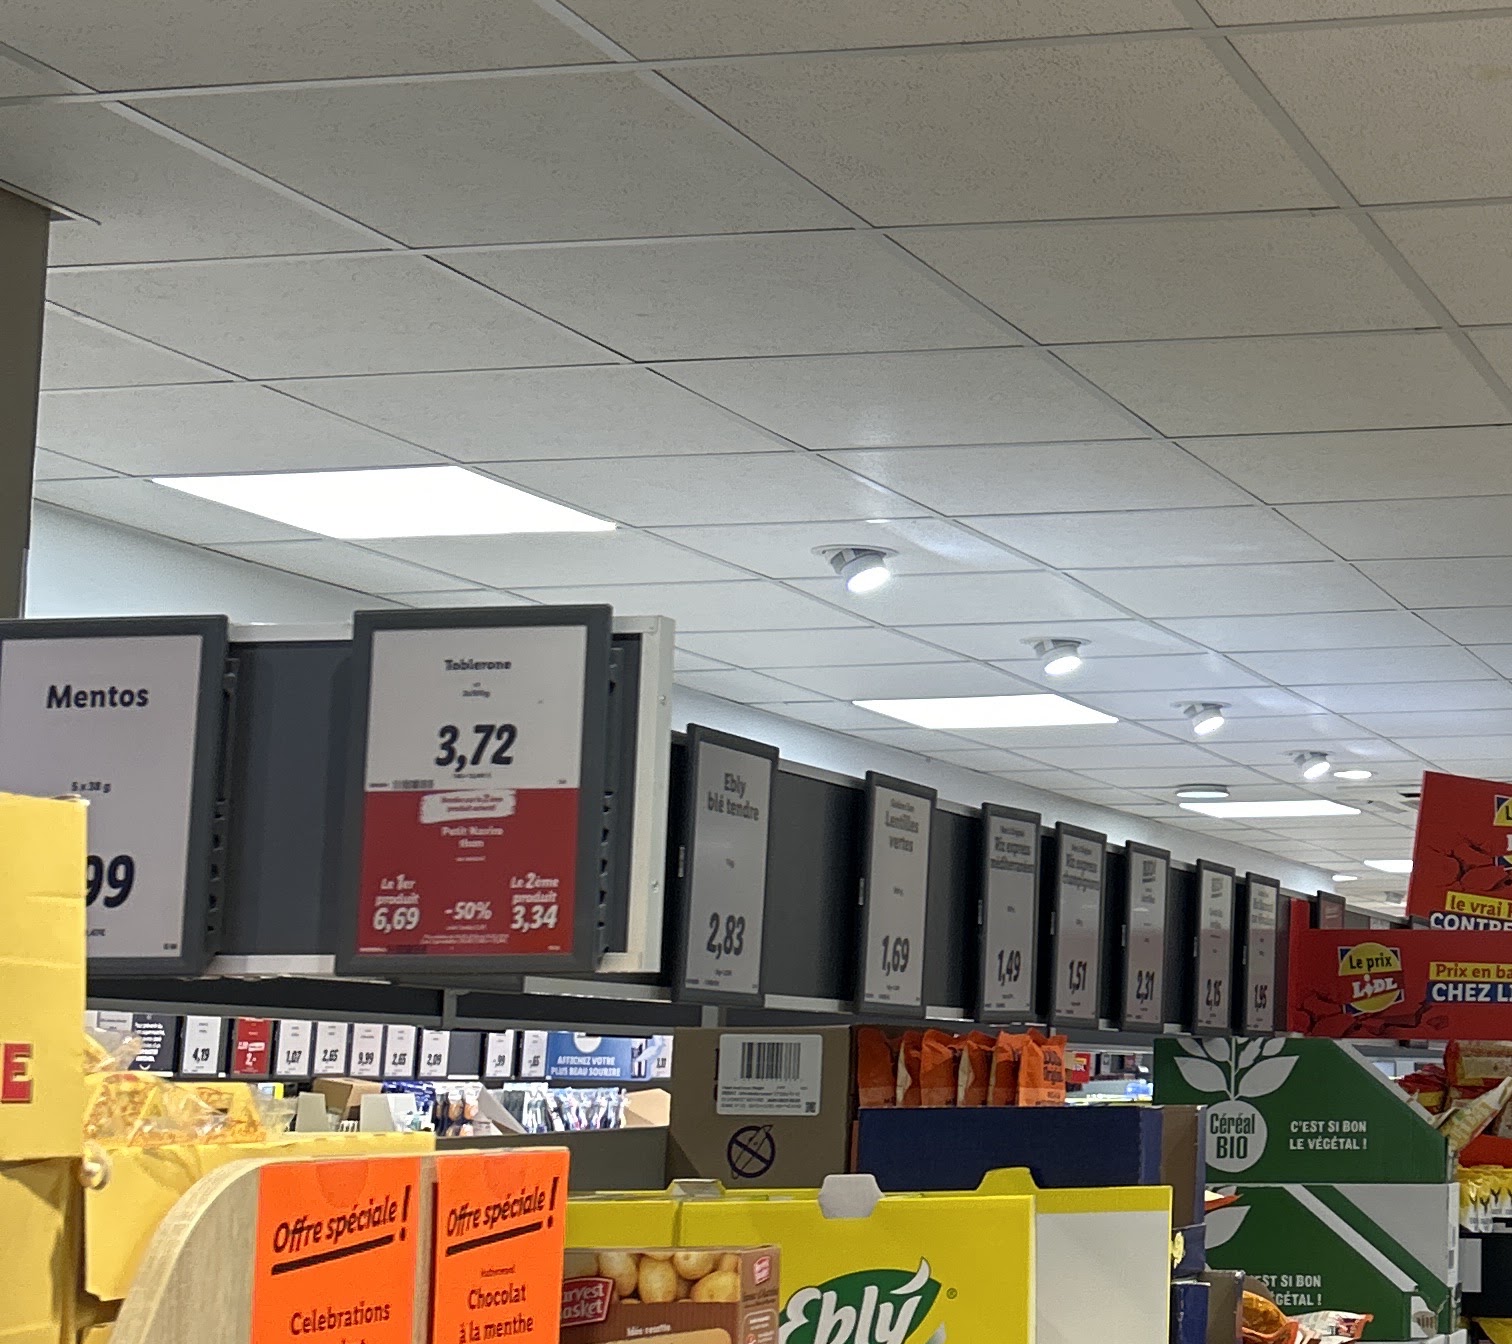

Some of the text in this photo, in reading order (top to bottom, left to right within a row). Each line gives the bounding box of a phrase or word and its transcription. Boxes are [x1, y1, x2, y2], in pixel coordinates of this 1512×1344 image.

[445, 659, 512, 672] Toblerone
[46, 684, 150, 710] Mentos
[435, 722, 519, 773] 3,72
[723, 772, 747, 799] Ebly
[707, 791, 760, 822] blé tendre
[380, 878, 395, 890] Le
[510, 876, 525, 889] Le
[375, 894, 420, 907] produit
[512, 891, 558, 904] produit
[1450, 895, 1467, 912] le
[1470, 901, 1504, 918] vrai
[373, 907, 420, 934] 6,69
[444, 901, 493, 921] -50%
[510, 904, 559, 933] 3,34
[706, 911, 746, 959] 2,83
[881, 935, 910, 976] 1,69
[1350, 953, 1392, 972] Le prix
[997, 950, 1021, 986] 1,49
[1068, 959, 1088, 995] 1,51
[1435, 963, 1469, 979] Prix
[1472, 968, 1491, 979] en
[1431, 983, 1492, 1002] CHEZ
[1210, 1112, 1256, 1135] Céréal
[1290, 1120, 1368, 1133] C'EST SI BON
[1216, 1136, 1248, 1159] BIO
[1289, 1135, 1368, 1150] LE VÉGÉTAL !
[446, 1176, 560, 1237] Offre spéciale !
[273, 1184, 412, 1254] Offre spéciale !
[1280, 1274, 1293, 1288] SI
[1296, 1274, 1322, 1288] BON
[467, 1283, 527, 1310] Chocolat
[1275, 1290, 1315, 1306] GÉTAL
[290, 1301, 391, 1336] Celebrations
[469, 1320, 481, 1343] la
[483, 1313, 534, 1341] menthe
